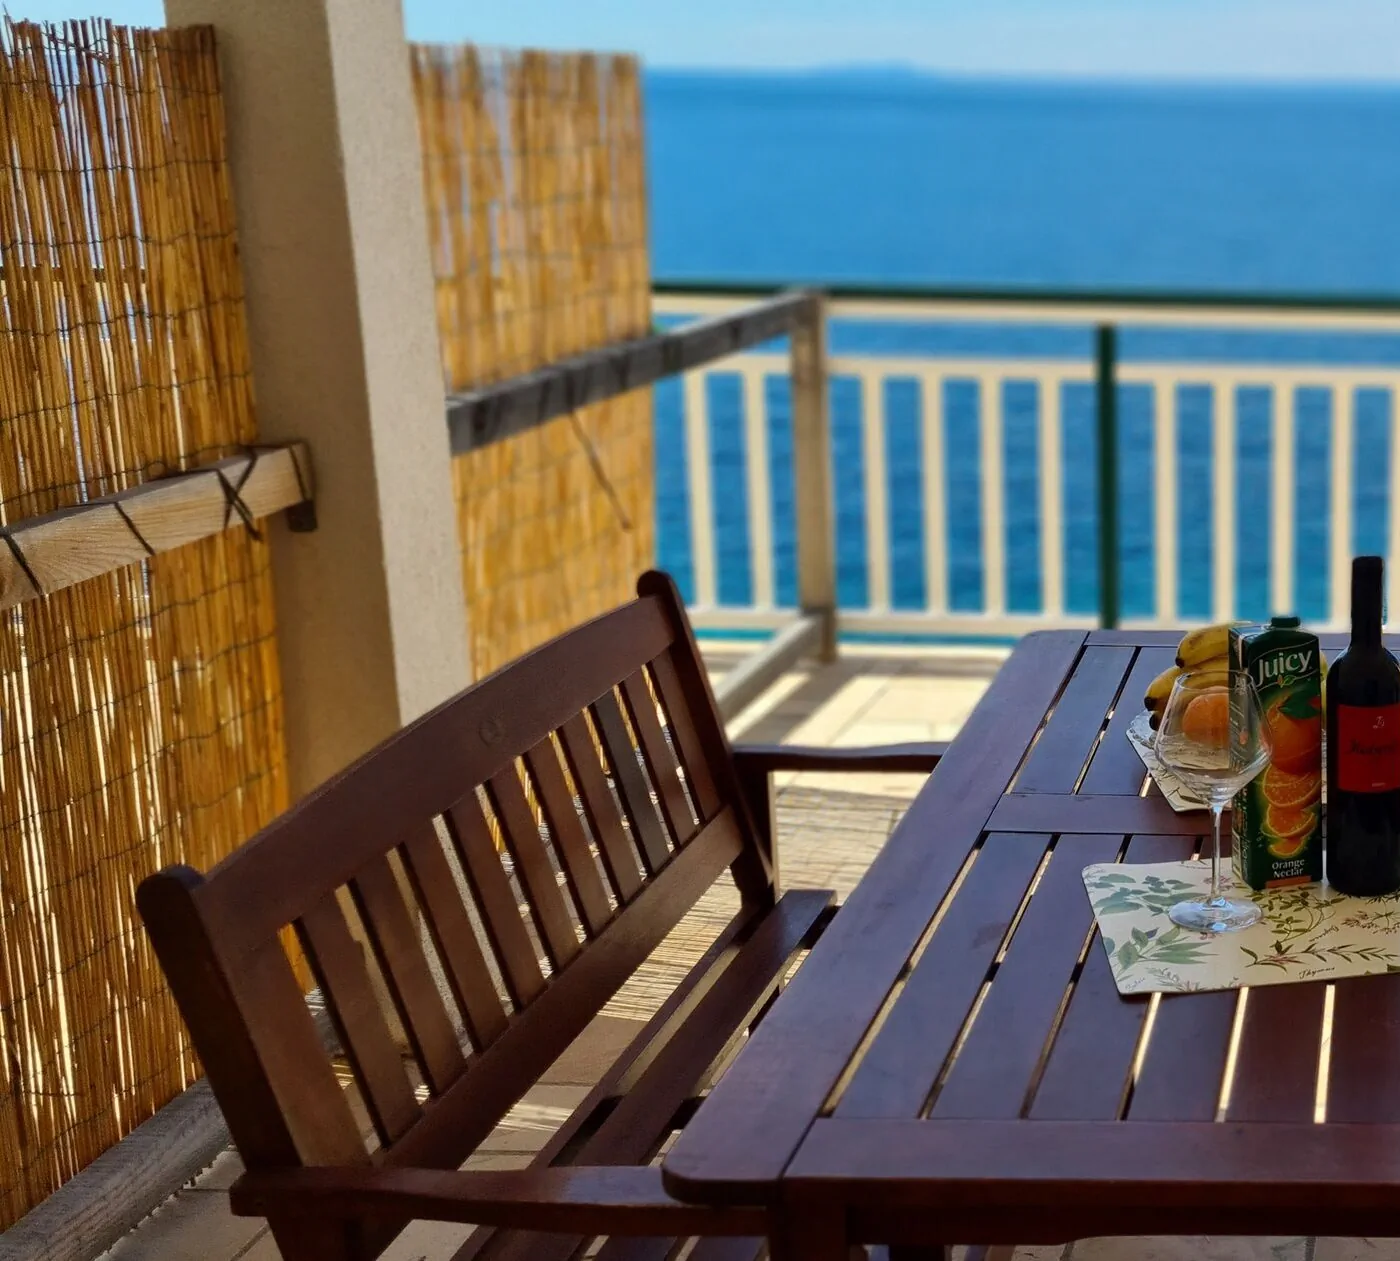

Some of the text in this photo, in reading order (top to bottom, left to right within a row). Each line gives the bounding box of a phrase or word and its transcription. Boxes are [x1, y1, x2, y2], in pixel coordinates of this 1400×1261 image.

[1255, 650, 1313, 687] Juicy
[1272, 859, 1305, 870] Orange
[1273, 868, 1304, 878] Nectar
